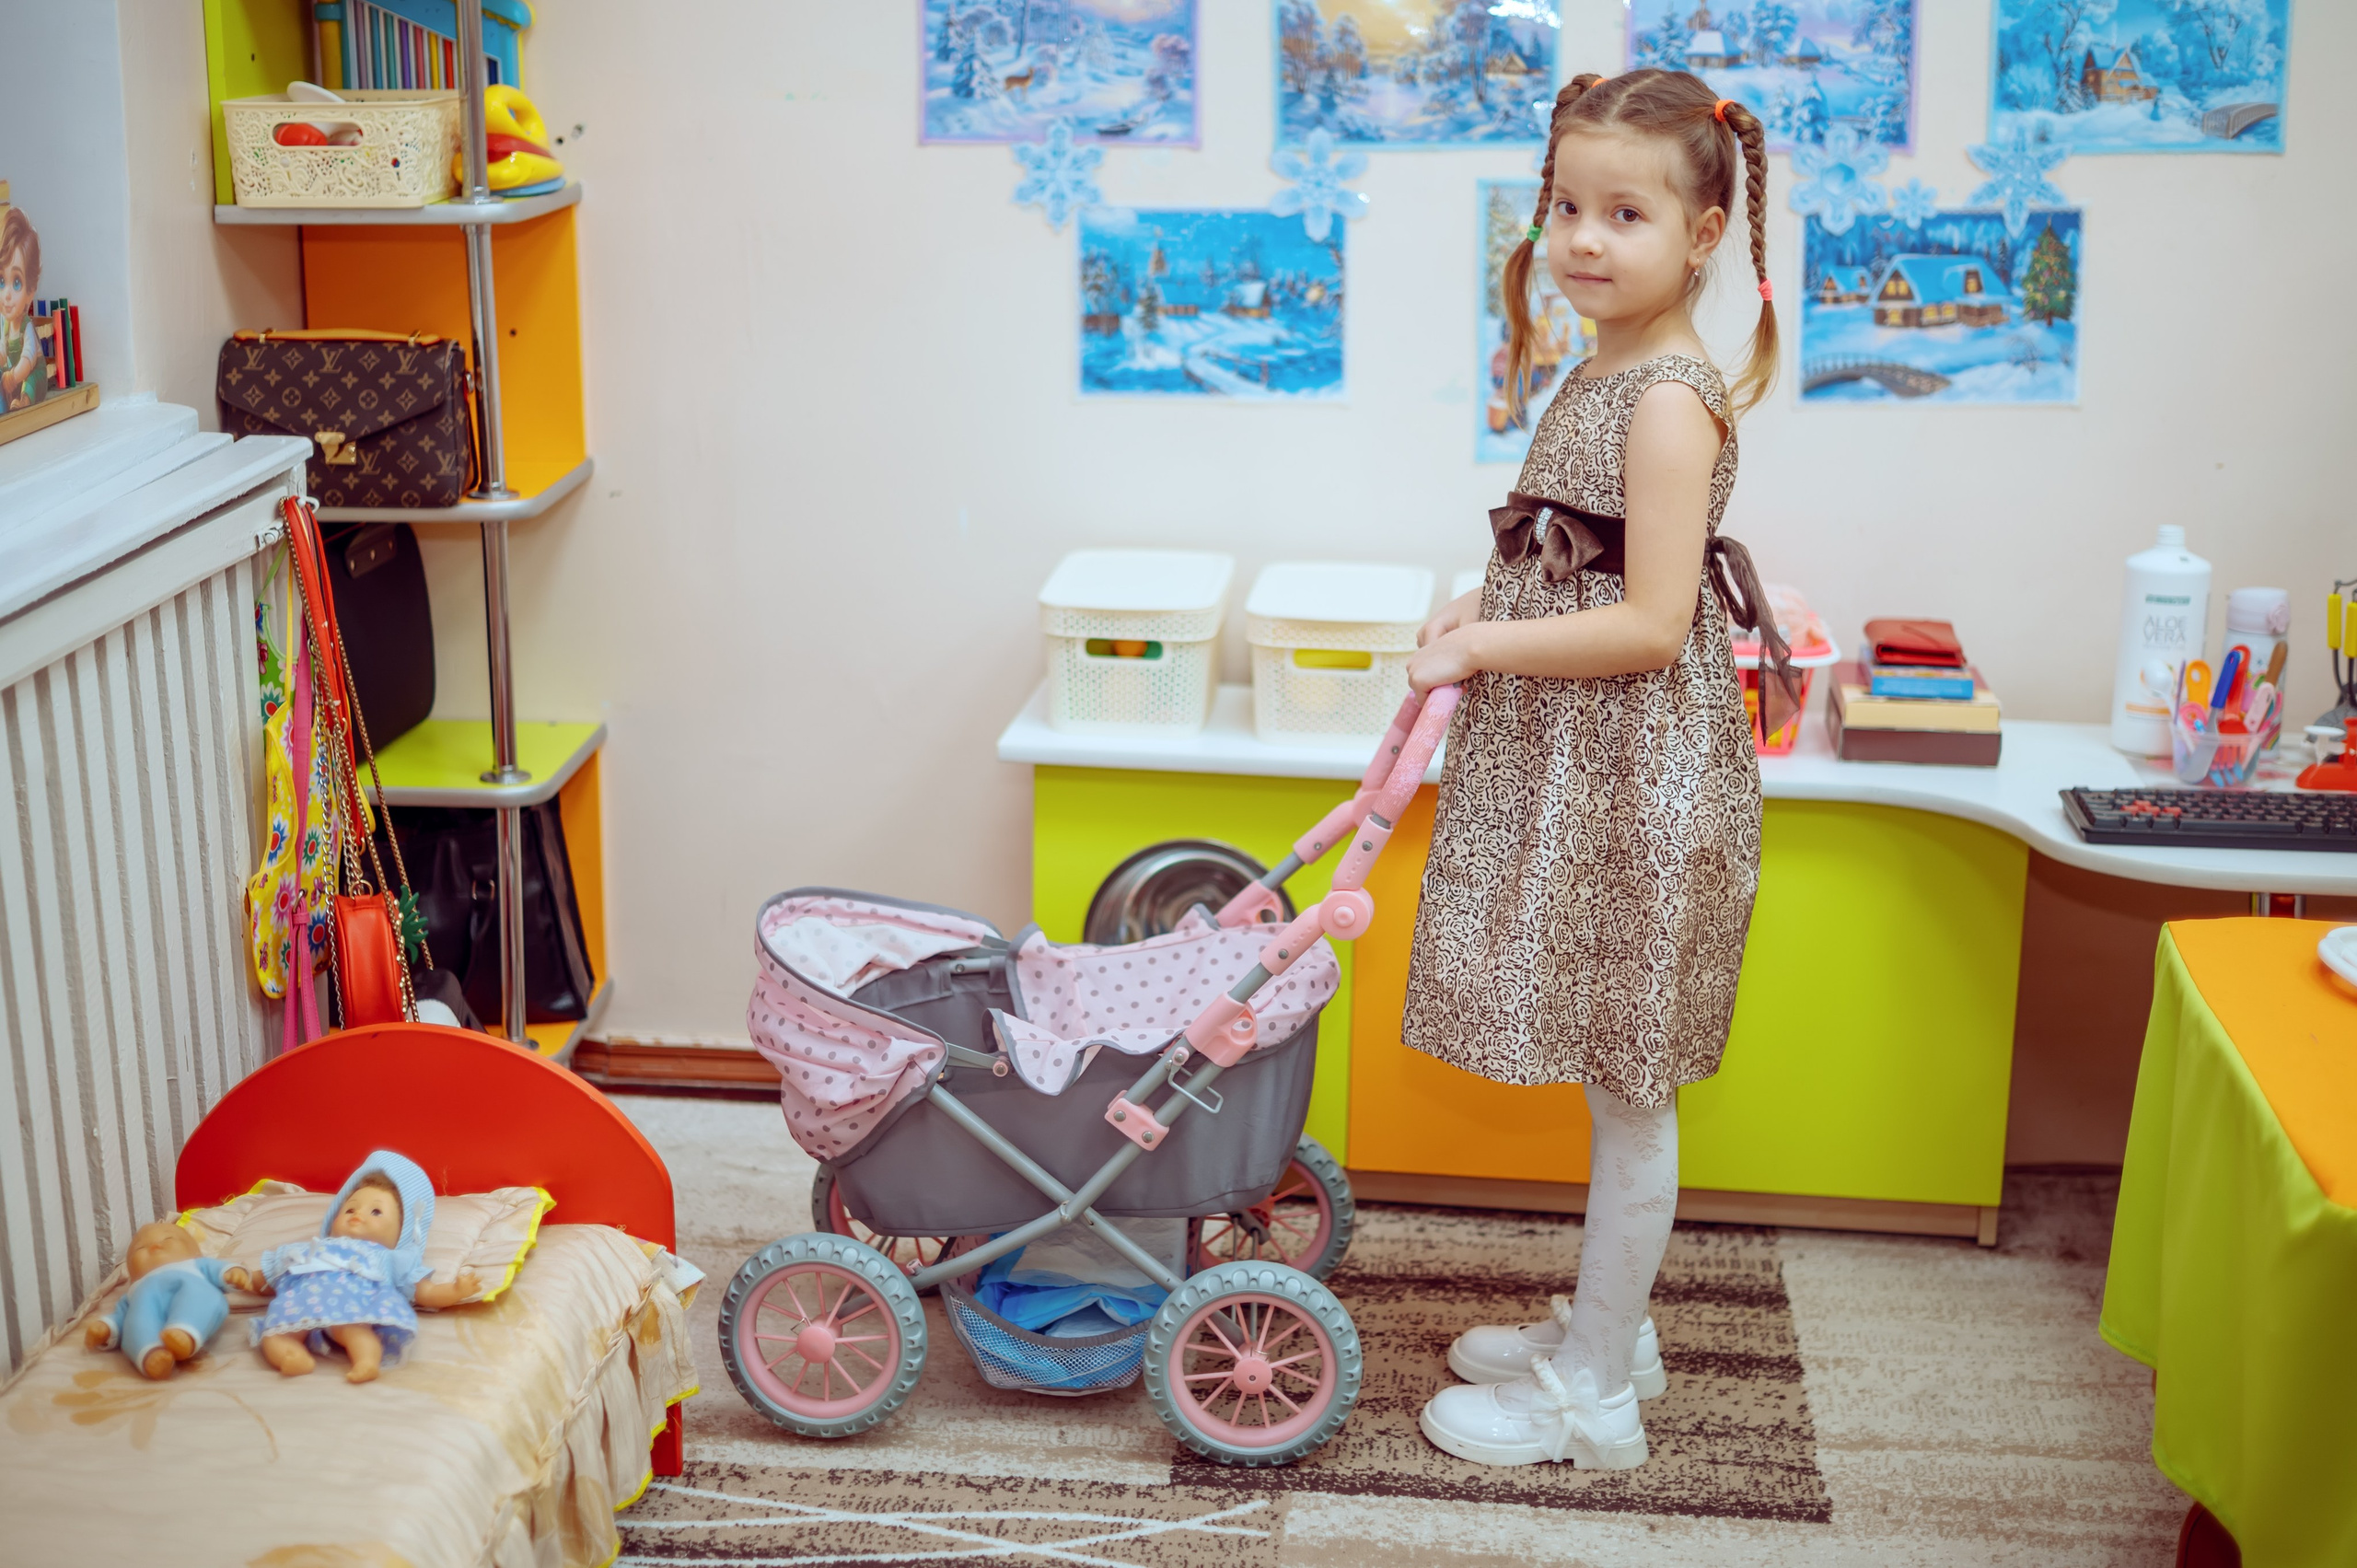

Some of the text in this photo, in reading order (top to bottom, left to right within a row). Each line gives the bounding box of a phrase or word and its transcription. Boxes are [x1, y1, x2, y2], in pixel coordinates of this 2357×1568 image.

[242, 346, 421, 375] LV LV LV
[358, 449, 459, 476] LV LV
[2143, 614, 2188, 630] ALOE
[2142, 629, 2187, 645] VERA
